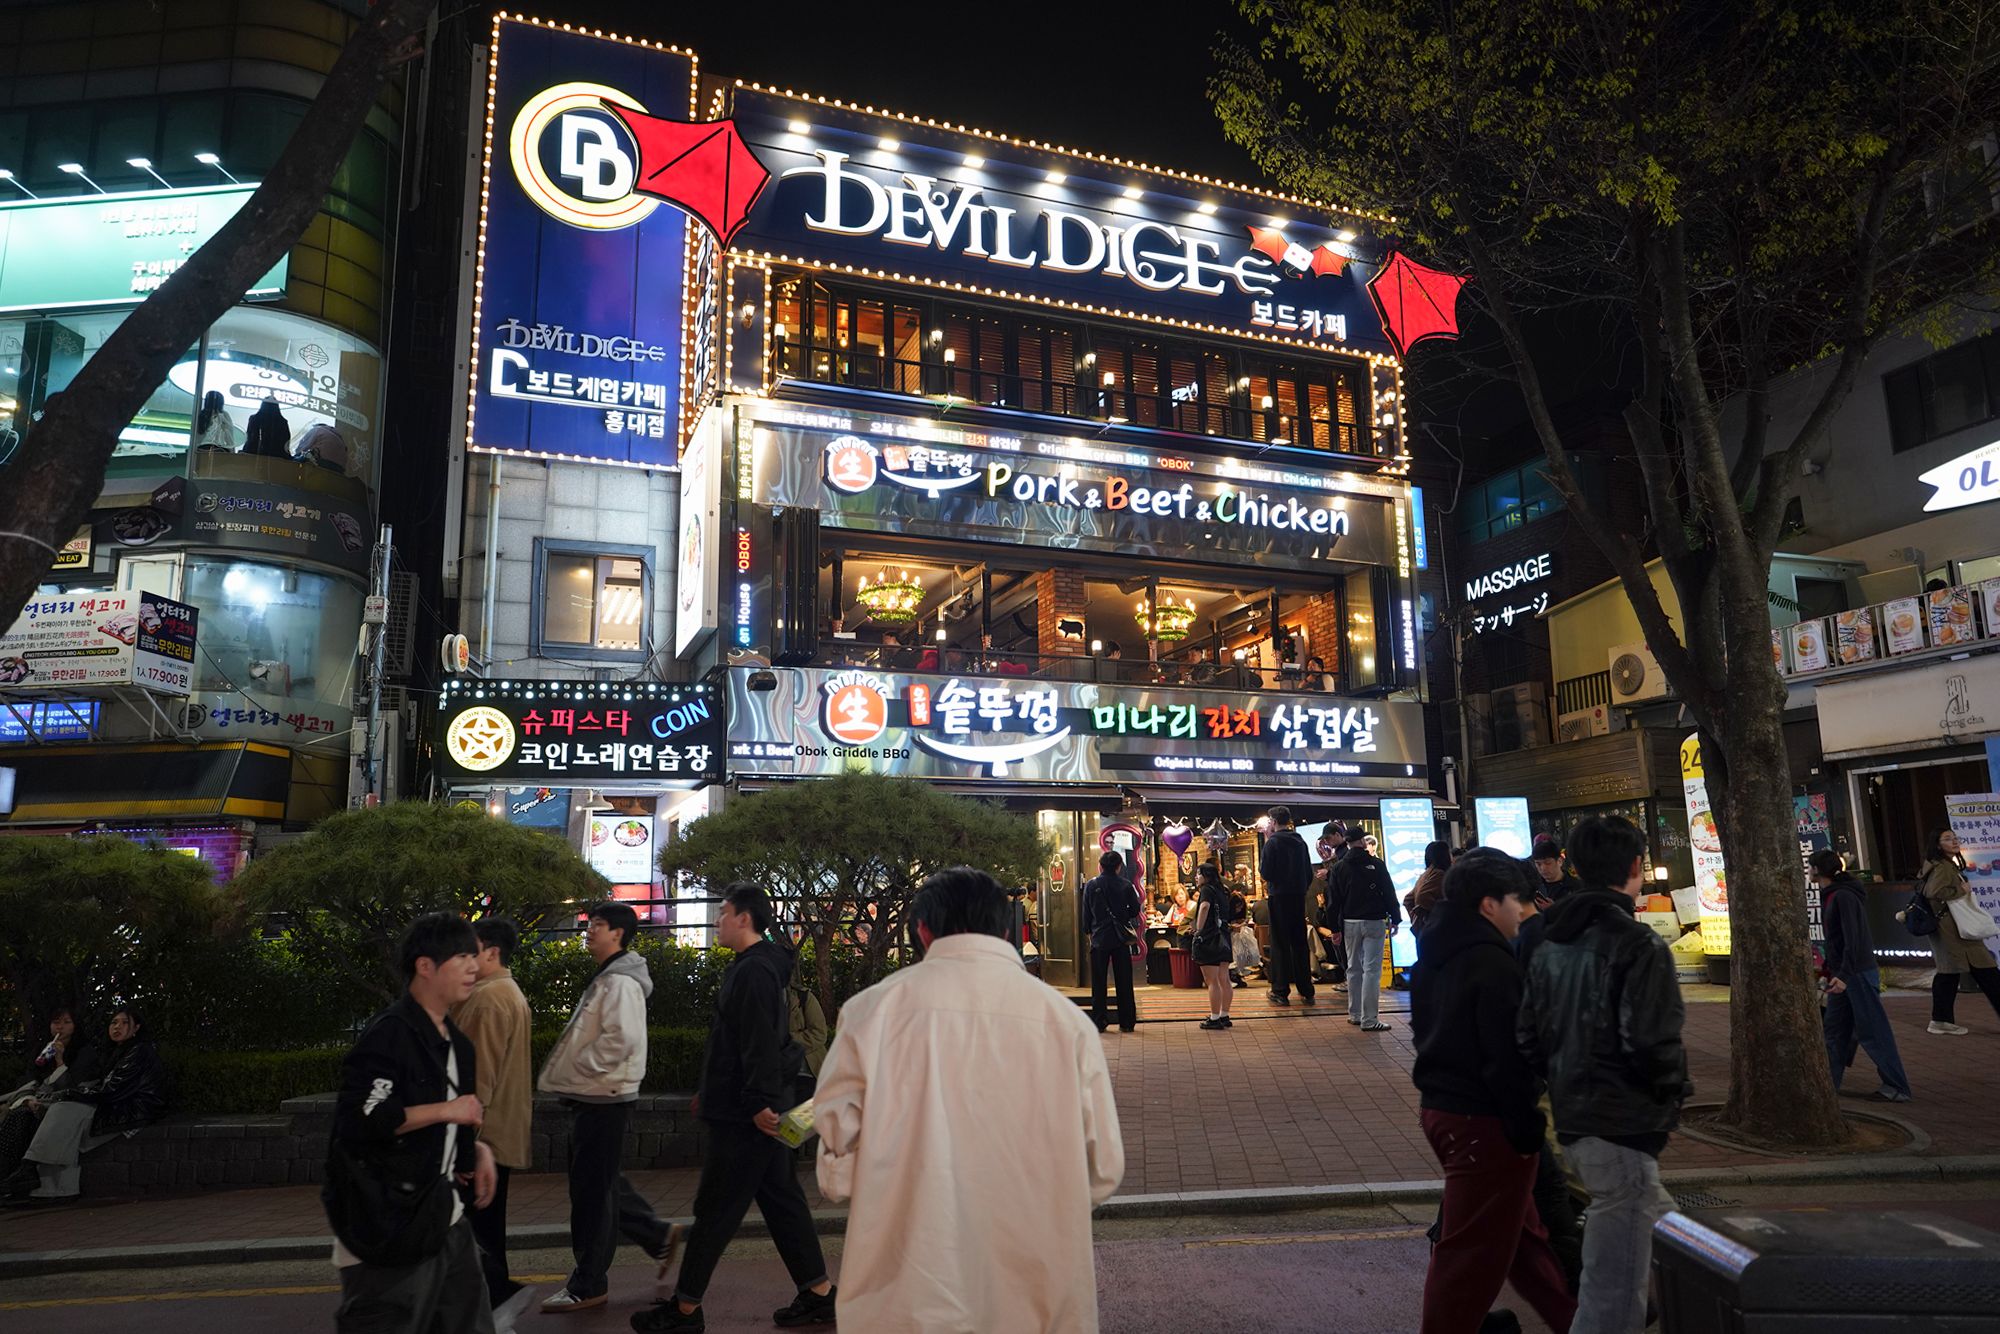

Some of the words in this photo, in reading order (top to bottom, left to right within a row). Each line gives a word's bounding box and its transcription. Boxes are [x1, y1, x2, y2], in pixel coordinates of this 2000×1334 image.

[780, 149, 1040, 268] DEVIL
[1040, 207, 1281, 297] DICE
[1249, 299, 1347, 342] 보드카페
[496, 318, 580, 354] DEVIL
[580, 333, 666, 362] DICE
[604, 410, 665, 439] 홍대점
[835, 449, 872, 483] 生
[908, 445, 973, 477] 솥뚜껑
[1126, 452, 1149, 466] BBQ
[1283, 473, 1322, 487] Chicken
[987, 461, 1083, 507] Pork
[1083, 488, 1102, 509] &
[1105, 475, 1194, 519] Beef
[1195, 501, 1213, 522] &
[1215, 489, 1349, 536] Chicken
[67, 554, 79, 563] EAT
[1466, 553, 1551, 601] MASSAGE
[24, 601, 75, 619] 엉터리
[79, 599, 126, 617] 생고기
[738, 583, 751, 626] House
[1473, 592, 1549, 634] マッサージ
[158, 638, 193, 660] 무한리필
[52, 669, 87, 681] 무한리필
[461, 710, 480, 721] COIN
[834, 688, 881, 731] 生
[912, 686, 928, 722] 오복
[935, 678, 1059, 735] 솥뚜껑
[210, 708, 280, 728] 엉터리
[286, 713, 334, 733] 생고기
[519, 708, 633, 737] 슈퍼스타
[650, 698, 710, 740] COIN
[1091, 703, 1198, 739] 미나리
[1204, 705, 1260, 738] 김치
[1269, 703, 1380, 753] 삼겹살
[518, 741, 713, 773] 코인노래연습장
[795, 745, 829, 758] Obok
[832, 746, 879, 760] Griddle
[883, 748, 911, 760] BBQ
[1153, 756, 1194, 769] Original
[1195, 757, 1231, 770] Korean
[1231, 758, 1254, 771] BBQ
[1275, 760, 1298, 773] Pork
[1299, 761, 1308, 773] &
[1308, 762, 1330, 773] Beef
[1331, 762, 1361, 775] House
[512, 798, 539, 815] Super
[1958, 805, 1976, 814] OLU
[1981, 828, 1989, 836] &
